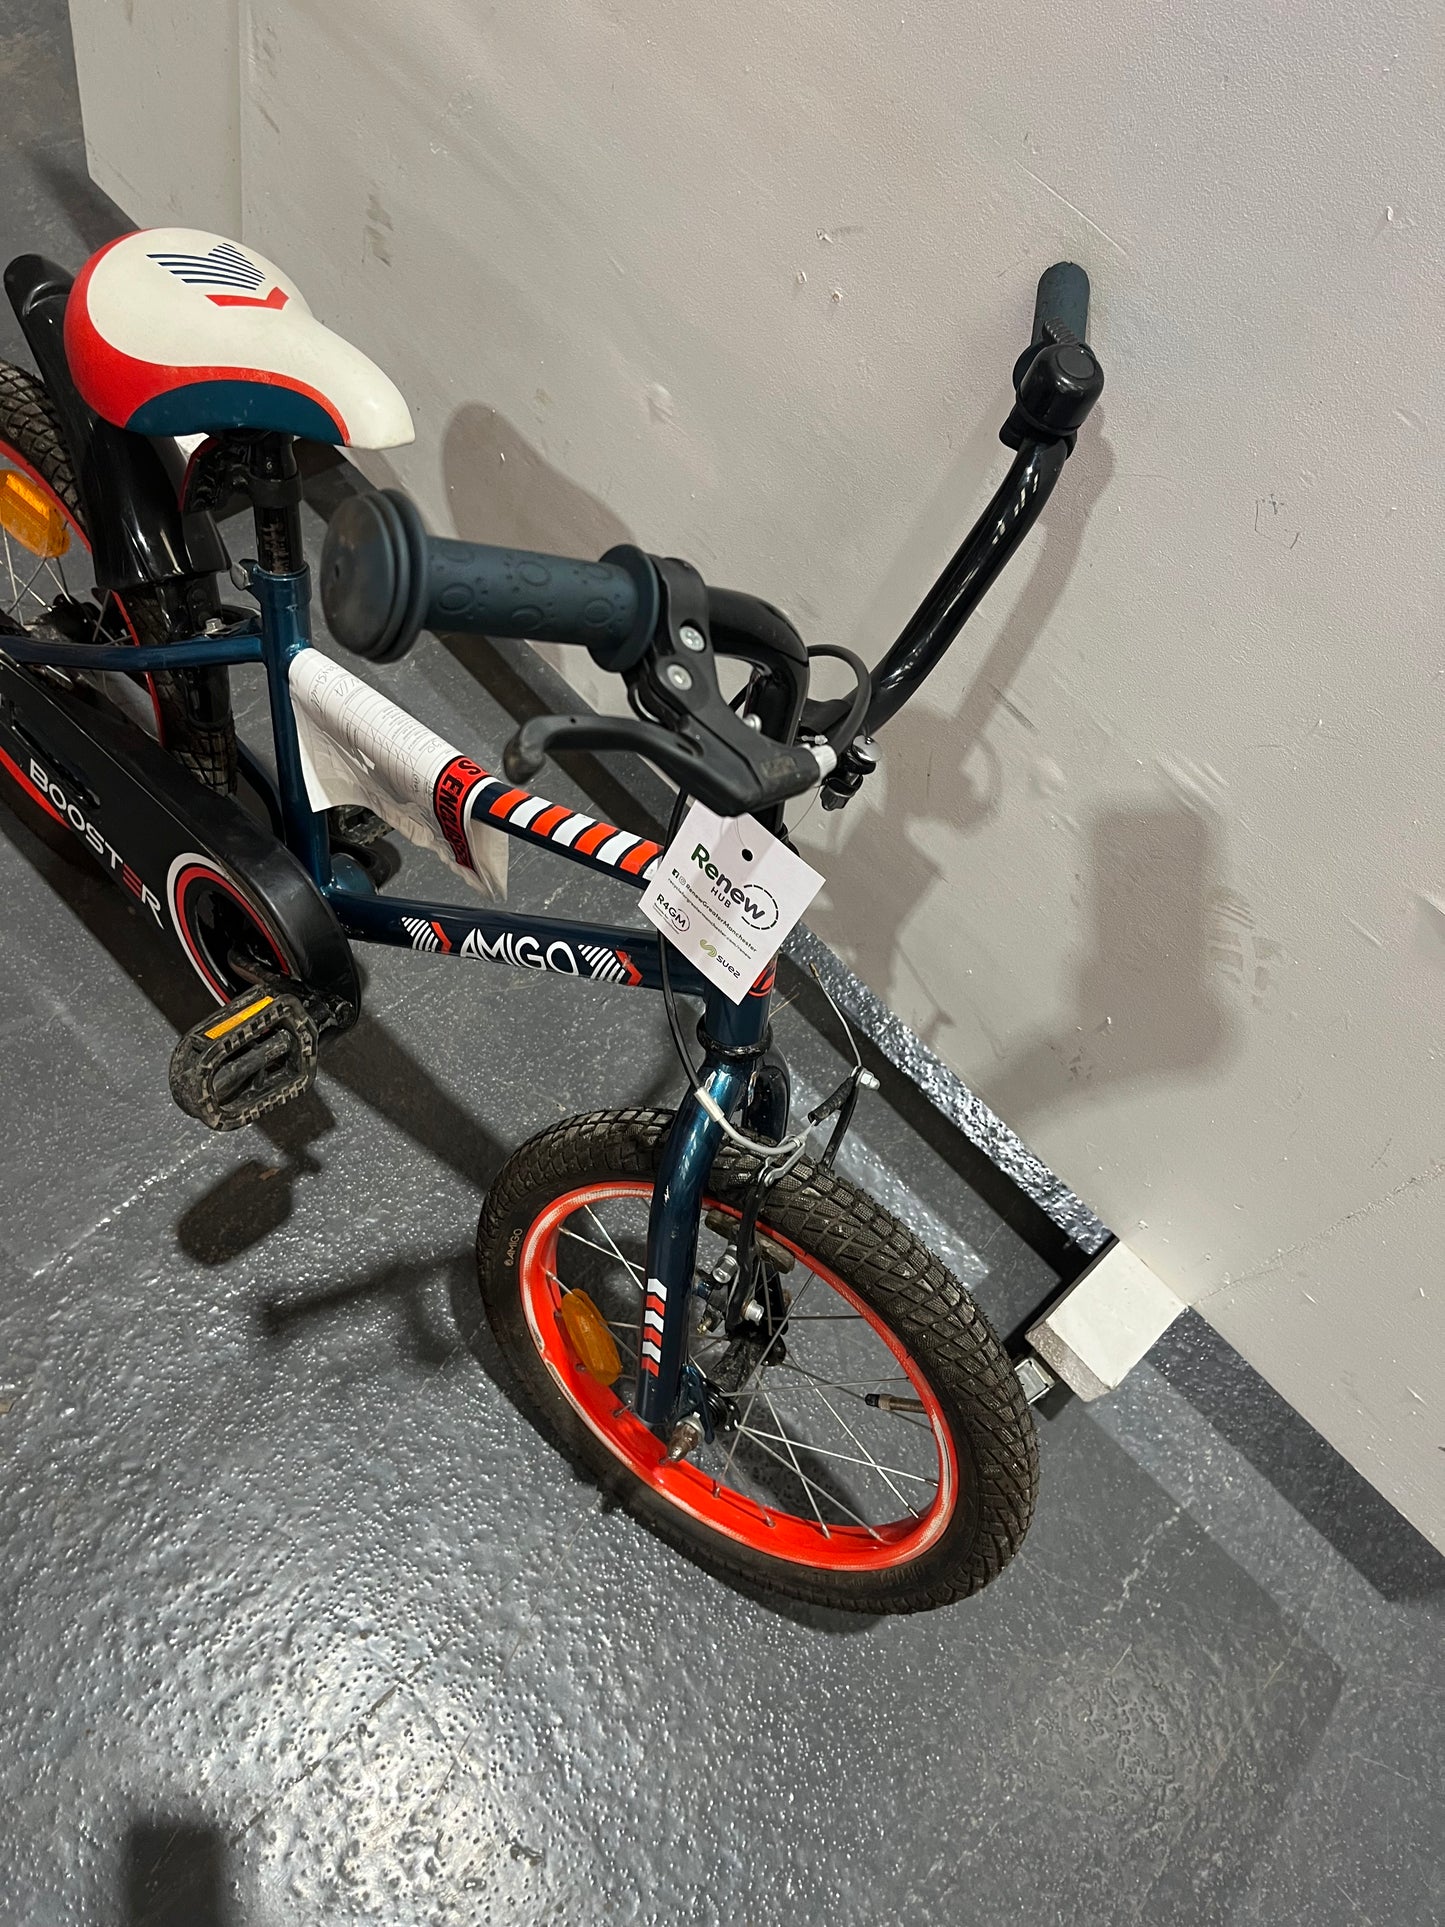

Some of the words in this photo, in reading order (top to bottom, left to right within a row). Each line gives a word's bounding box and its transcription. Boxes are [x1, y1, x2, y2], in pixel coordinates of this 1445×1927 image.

[29, 757, 165, 930] BOOSTER
[690, 843, 766, 920] Renew
[710, 886, 732, 909] HUB
[656, 893, 686, 928] R4GM
[685, 882, 757, 953] RenewGreaterManchester
[459, 928, 580, 976] AMIGO
[716, 954, 741, 979] suez
[506, 1228, 523, 1260] AMIGO
